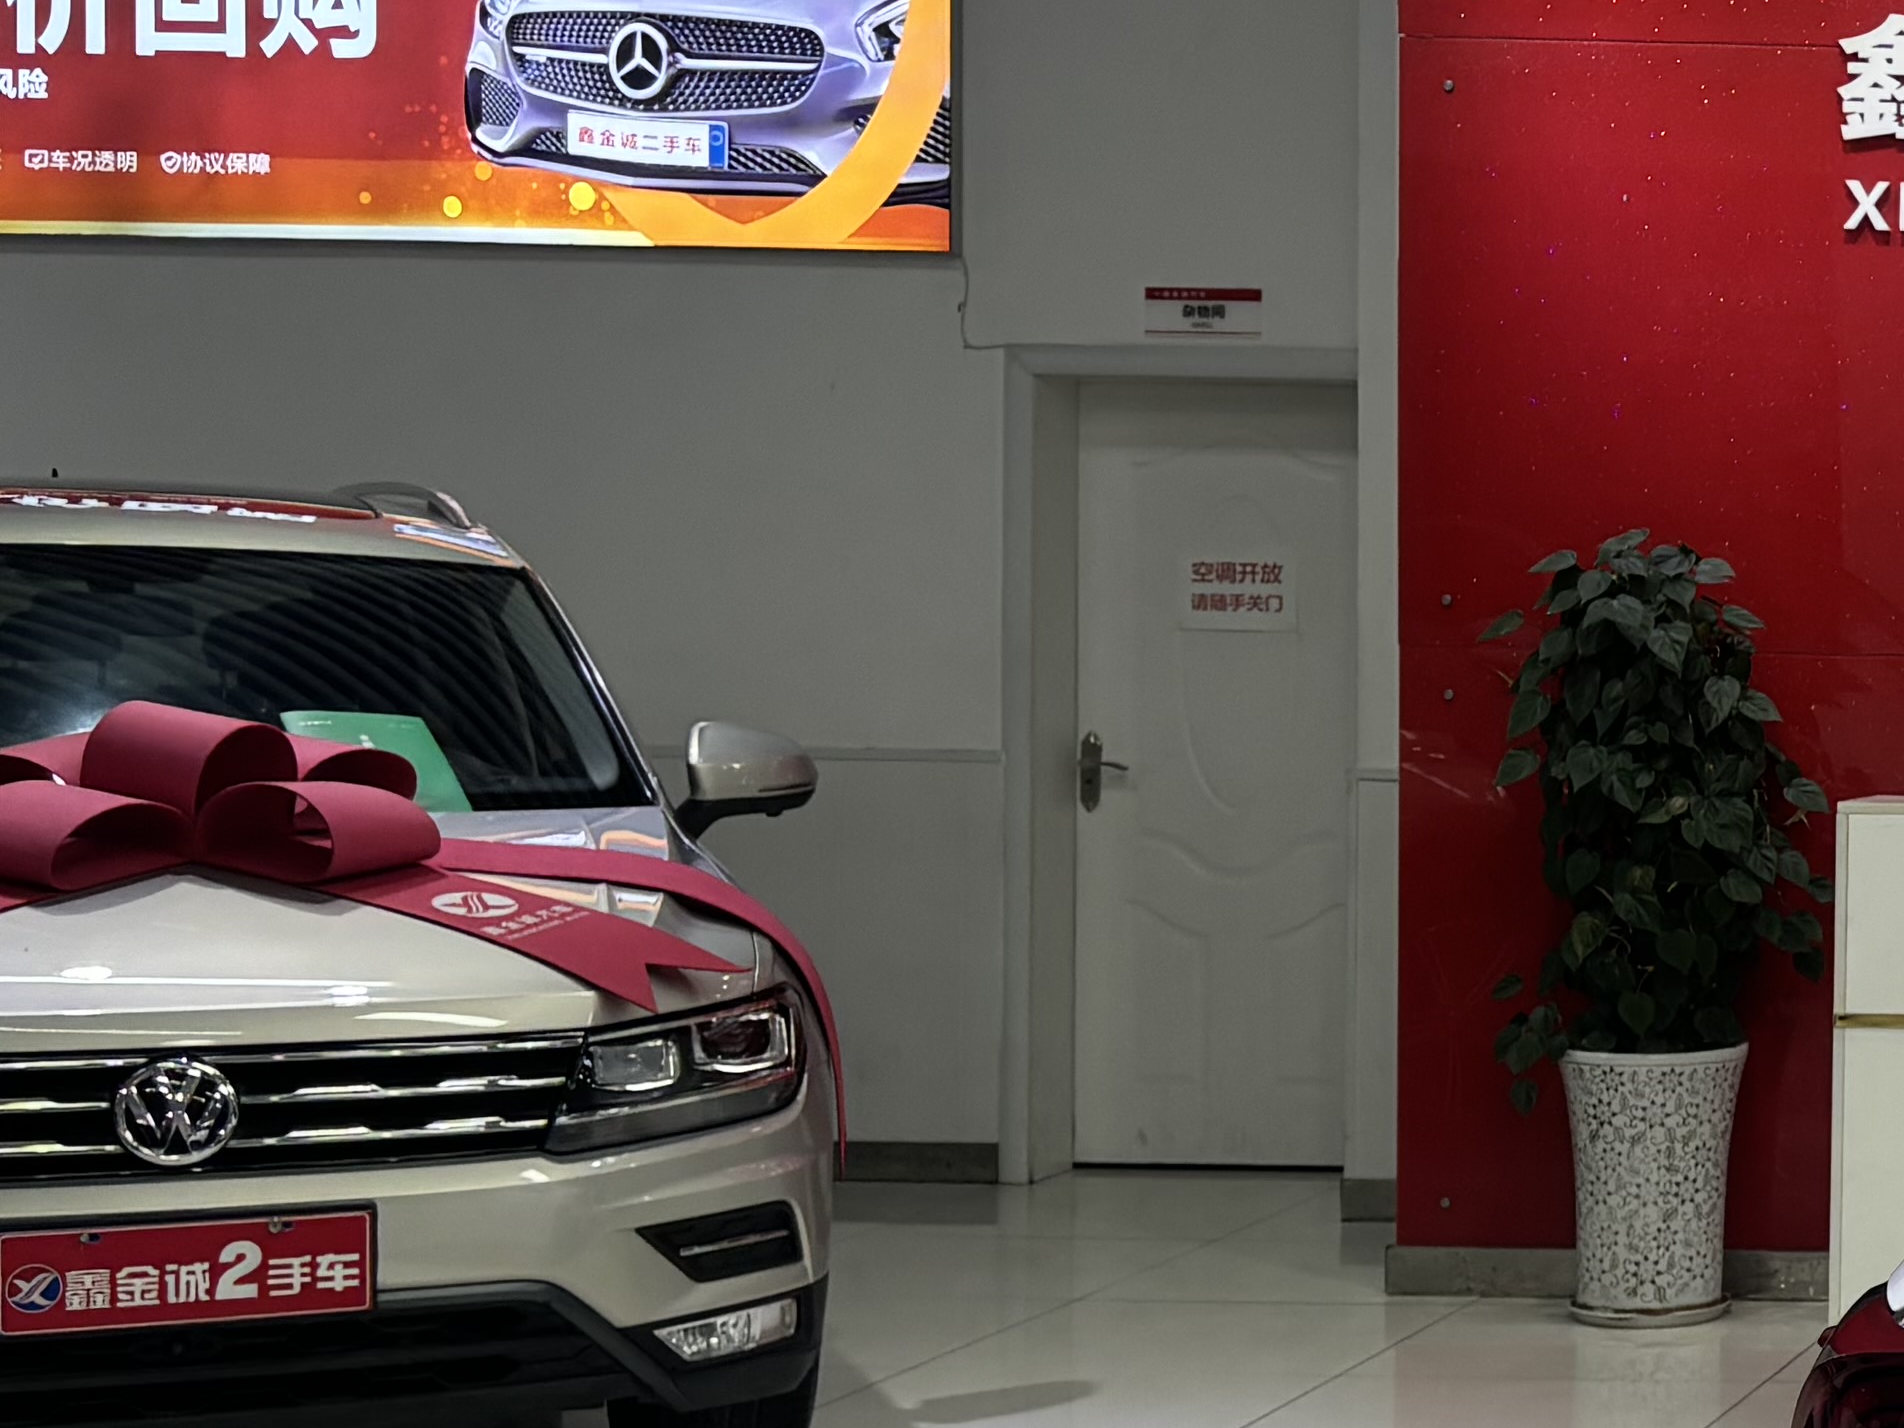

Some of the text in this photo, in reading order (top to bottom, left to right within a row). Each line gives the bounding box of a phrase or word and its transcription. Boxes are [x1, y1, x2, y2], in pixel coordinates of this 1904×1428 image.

[50, 149, 271, 175] 车况透明 协议保障
[1191, 561, 1284, 585] 空调开放
[65, 1239, 360, 1311] 鑫金诚2手车
